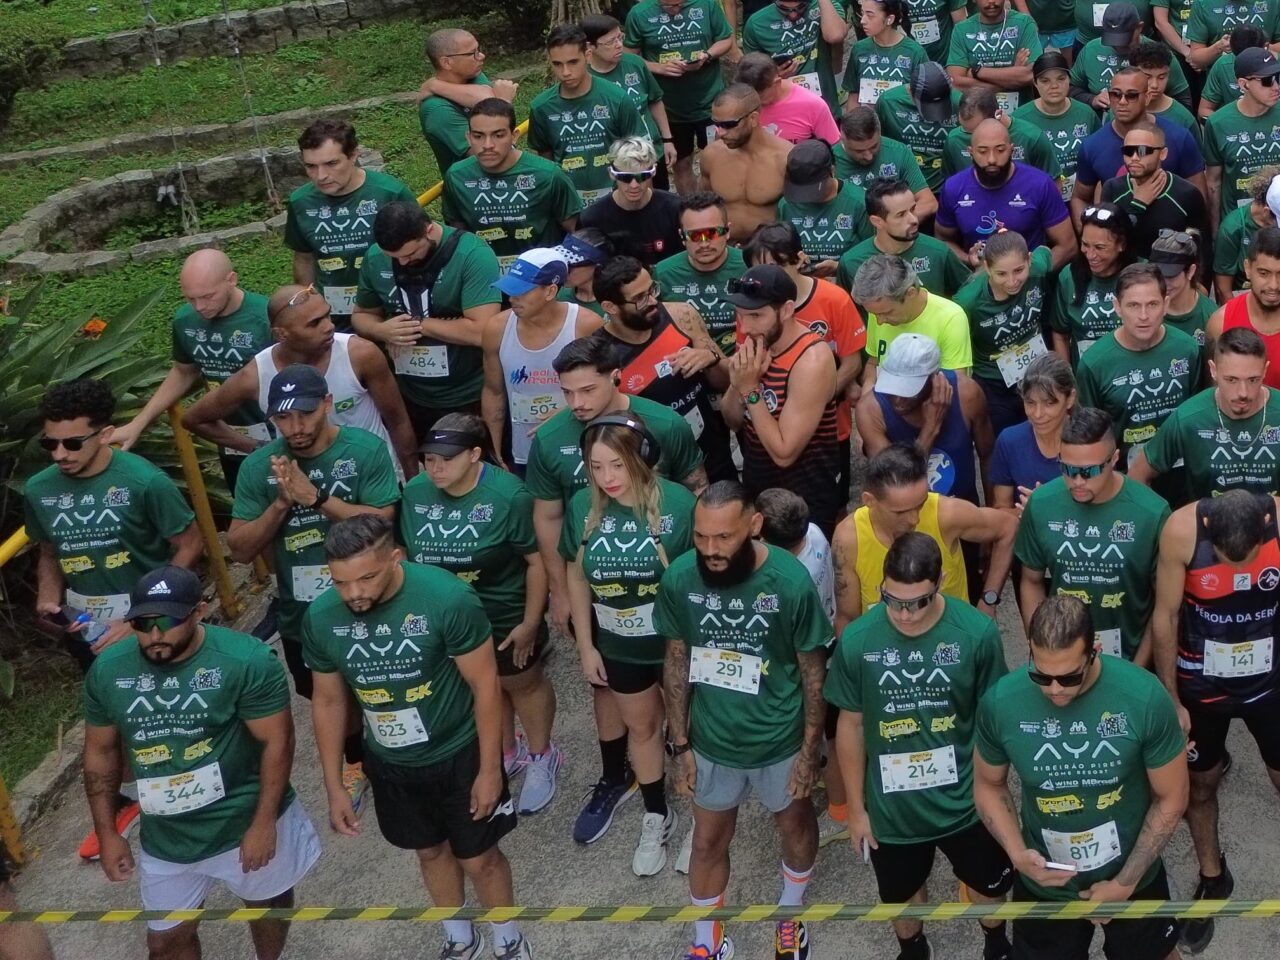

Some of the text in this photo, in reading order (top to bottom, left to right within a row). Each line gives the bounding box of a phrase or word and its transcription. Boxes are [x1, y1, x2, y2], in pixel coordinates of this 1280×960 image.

[410, 357, 436, 367] 484
[615, 617, 645, 628] 302
[1236, 613, 1252, 623] DA
[1230, 653, 1254, 667] 141
[716, 662, 742, 678] 291
[378, 723, 407, 737] 623
[908, 763, 938, 778] 214
[164, 783, 205, 803] 344
[1070, 842, 1100, 860] 817
